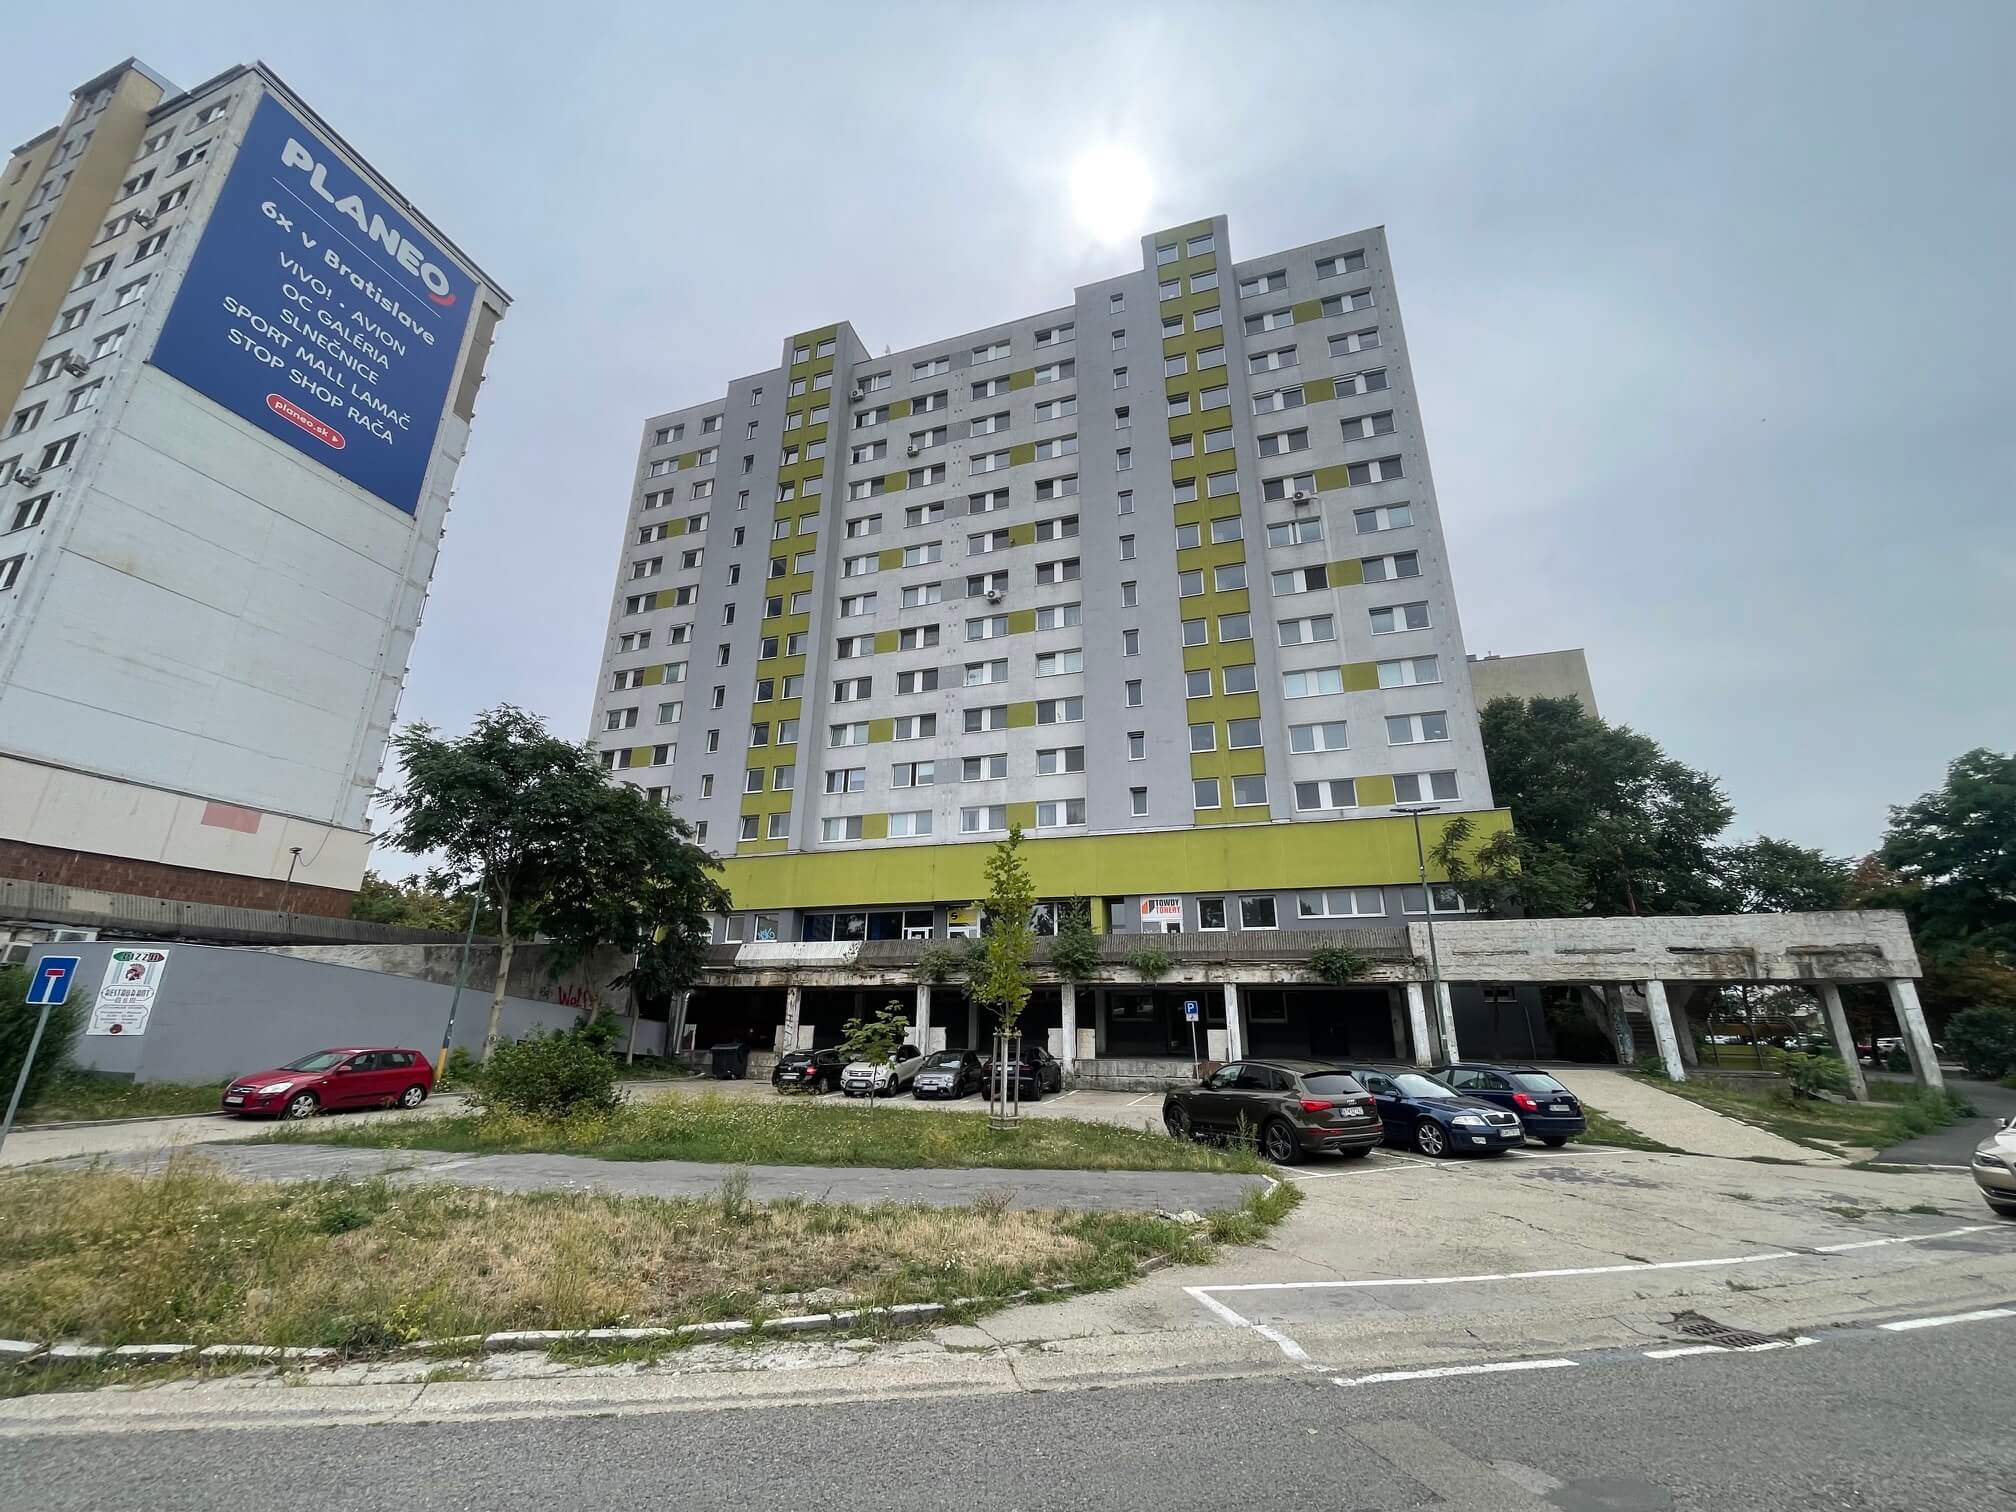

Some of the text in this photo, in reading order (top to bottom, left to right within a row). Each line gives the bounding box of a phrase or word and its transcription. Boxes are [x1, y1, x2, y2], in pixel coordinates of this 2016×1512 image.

[281, 137, 450, 296] PLANEO
[261, 201, 435, 346] 6x v Bratislave
[280, 251, 406, 357] VIVO! AVION
[282, 283, 389, 370] OC GALÉRIA
[223, 296, 411, 431] SPORT MALL LAMAČ
[228, 328, 394, 445] STOP SHOP RAČA
[280, 308, 380, 386] SLNEČNICE
[274, 400, 329, 438] planeo.sk
[1188, 1003, 1194, 1013] P
